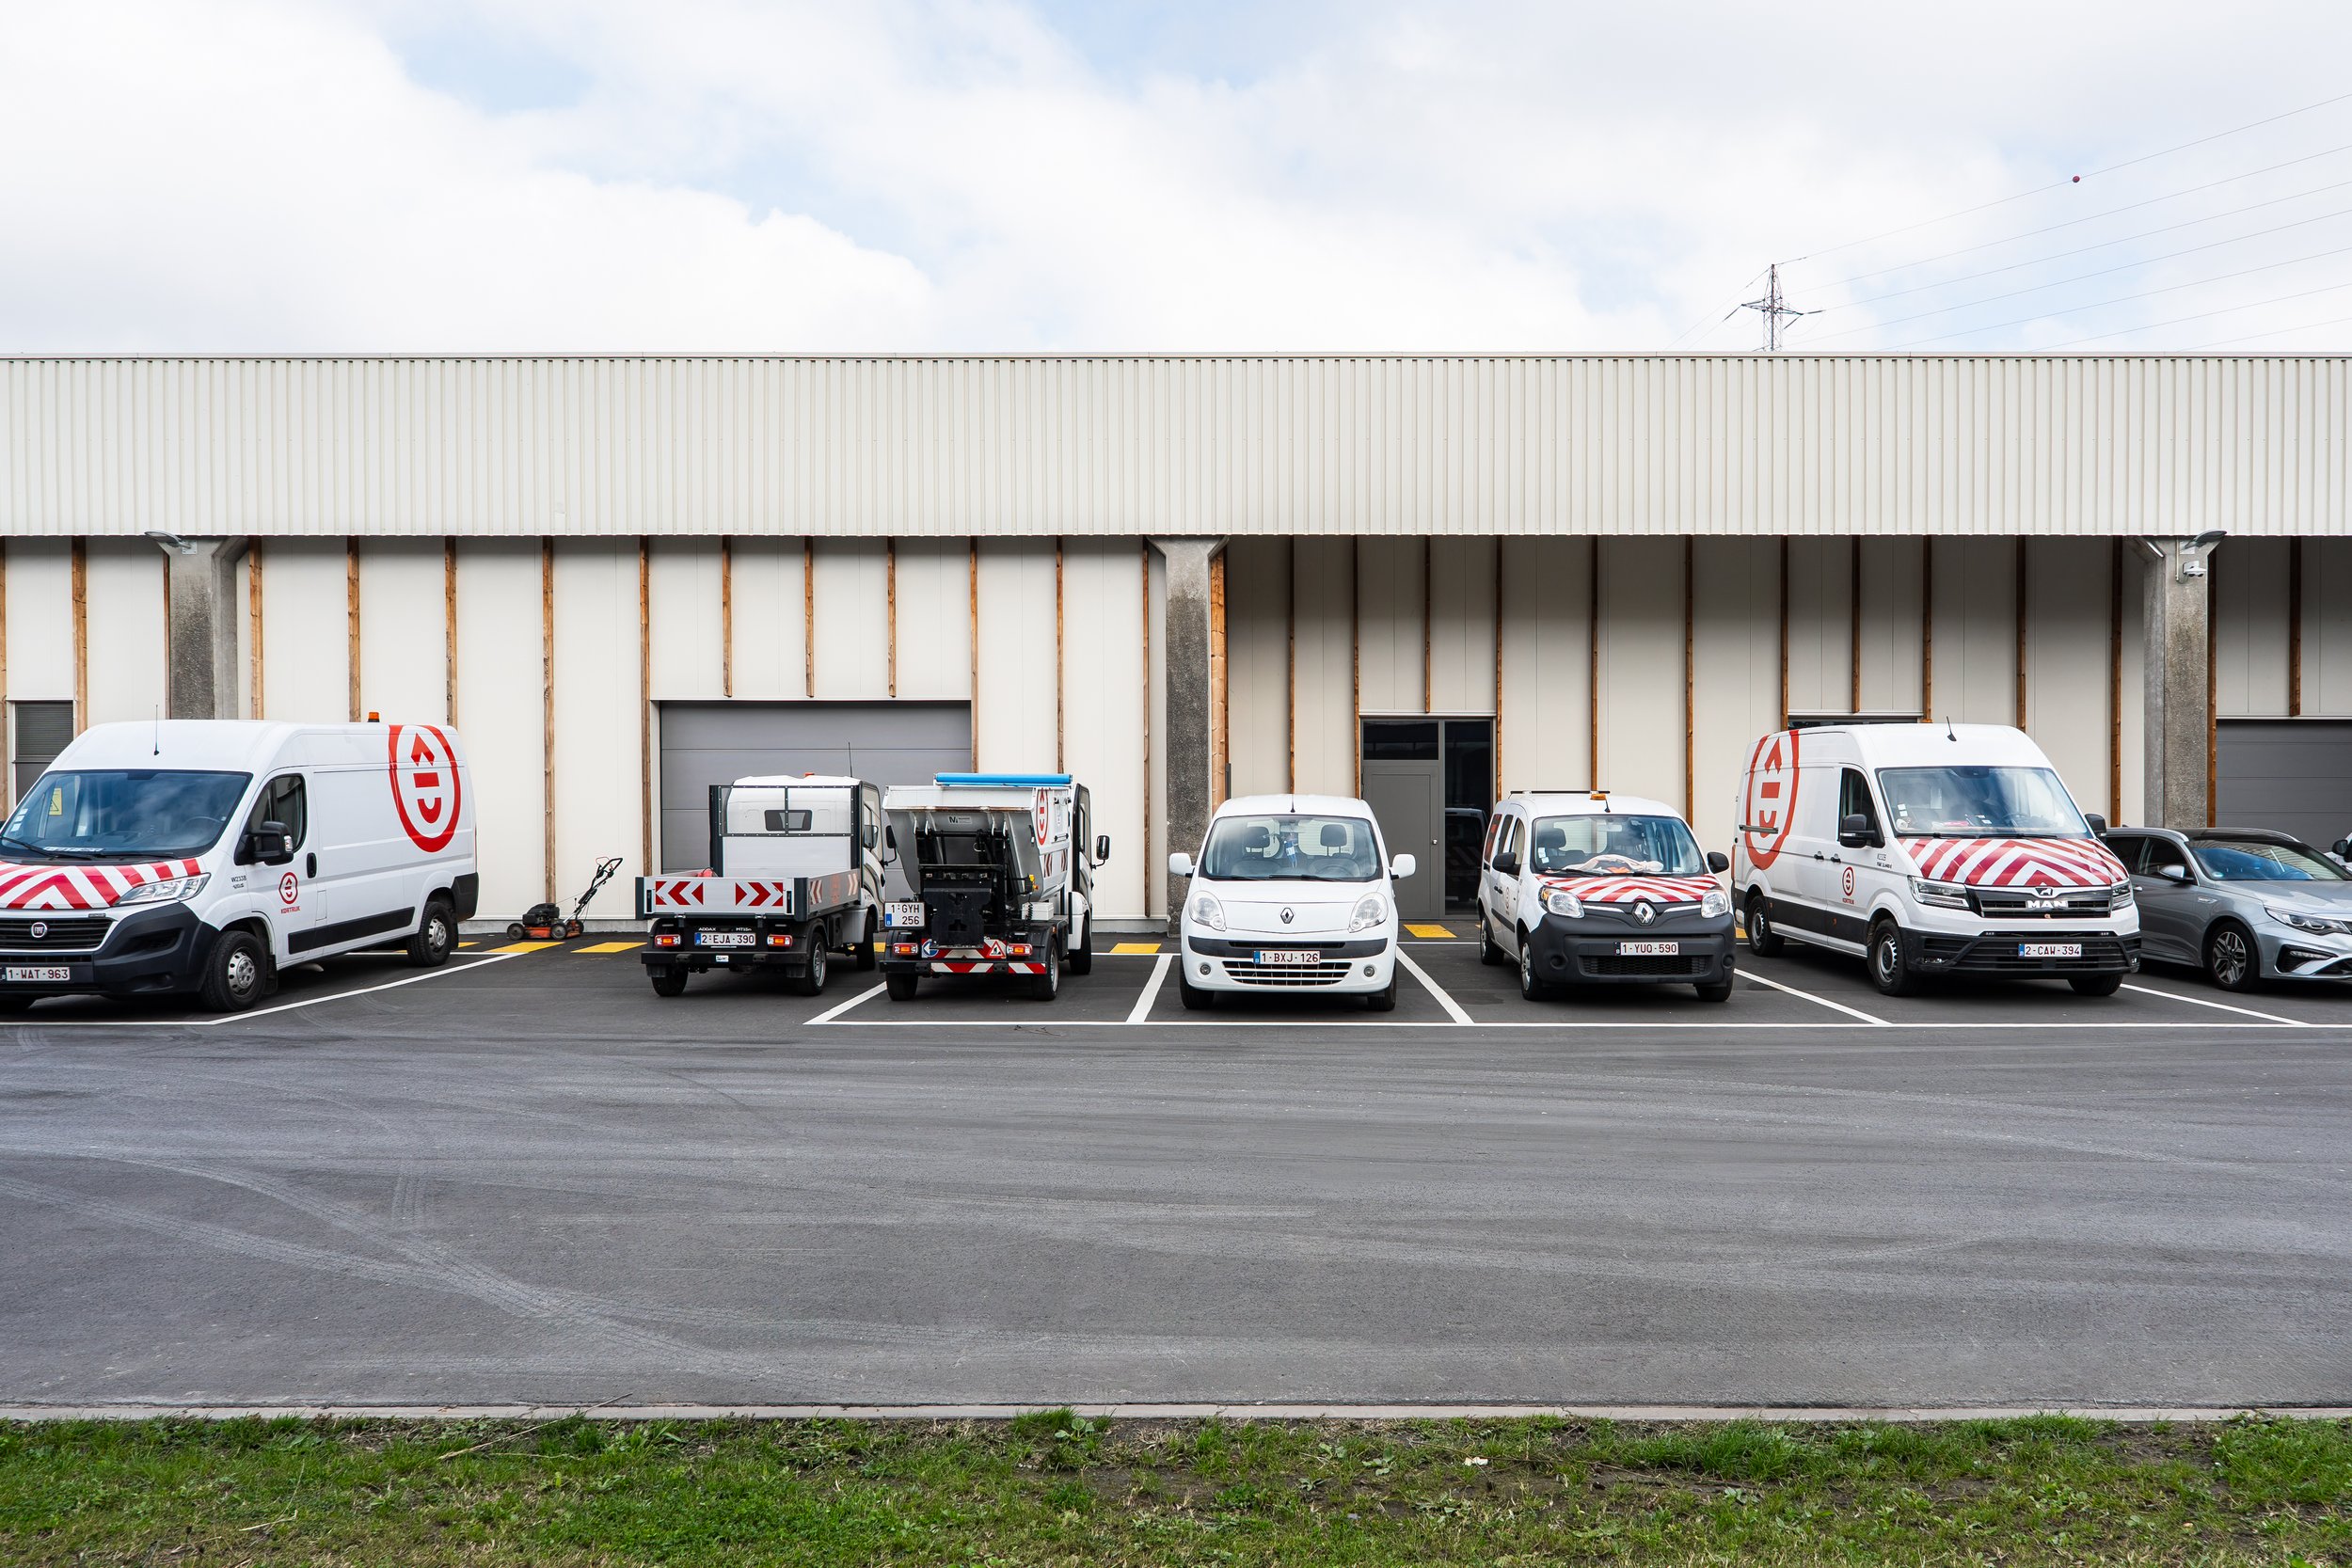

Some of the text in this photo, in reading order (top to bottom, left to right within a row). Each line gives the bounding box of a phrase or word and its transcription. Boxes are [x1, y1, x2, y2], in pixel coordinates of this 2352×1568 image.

[2026, 899, 2069, 909] MAN
[901, 915, 920, 926] 256
[702, 934, 755, 944] 2-EJA-390
[2026, 945, 2080, 956] 2-CAW-394
[1262, 953, 1319, 963] 1-BXJ-126
[8, 969, 68, 979] 1-WAT-963
